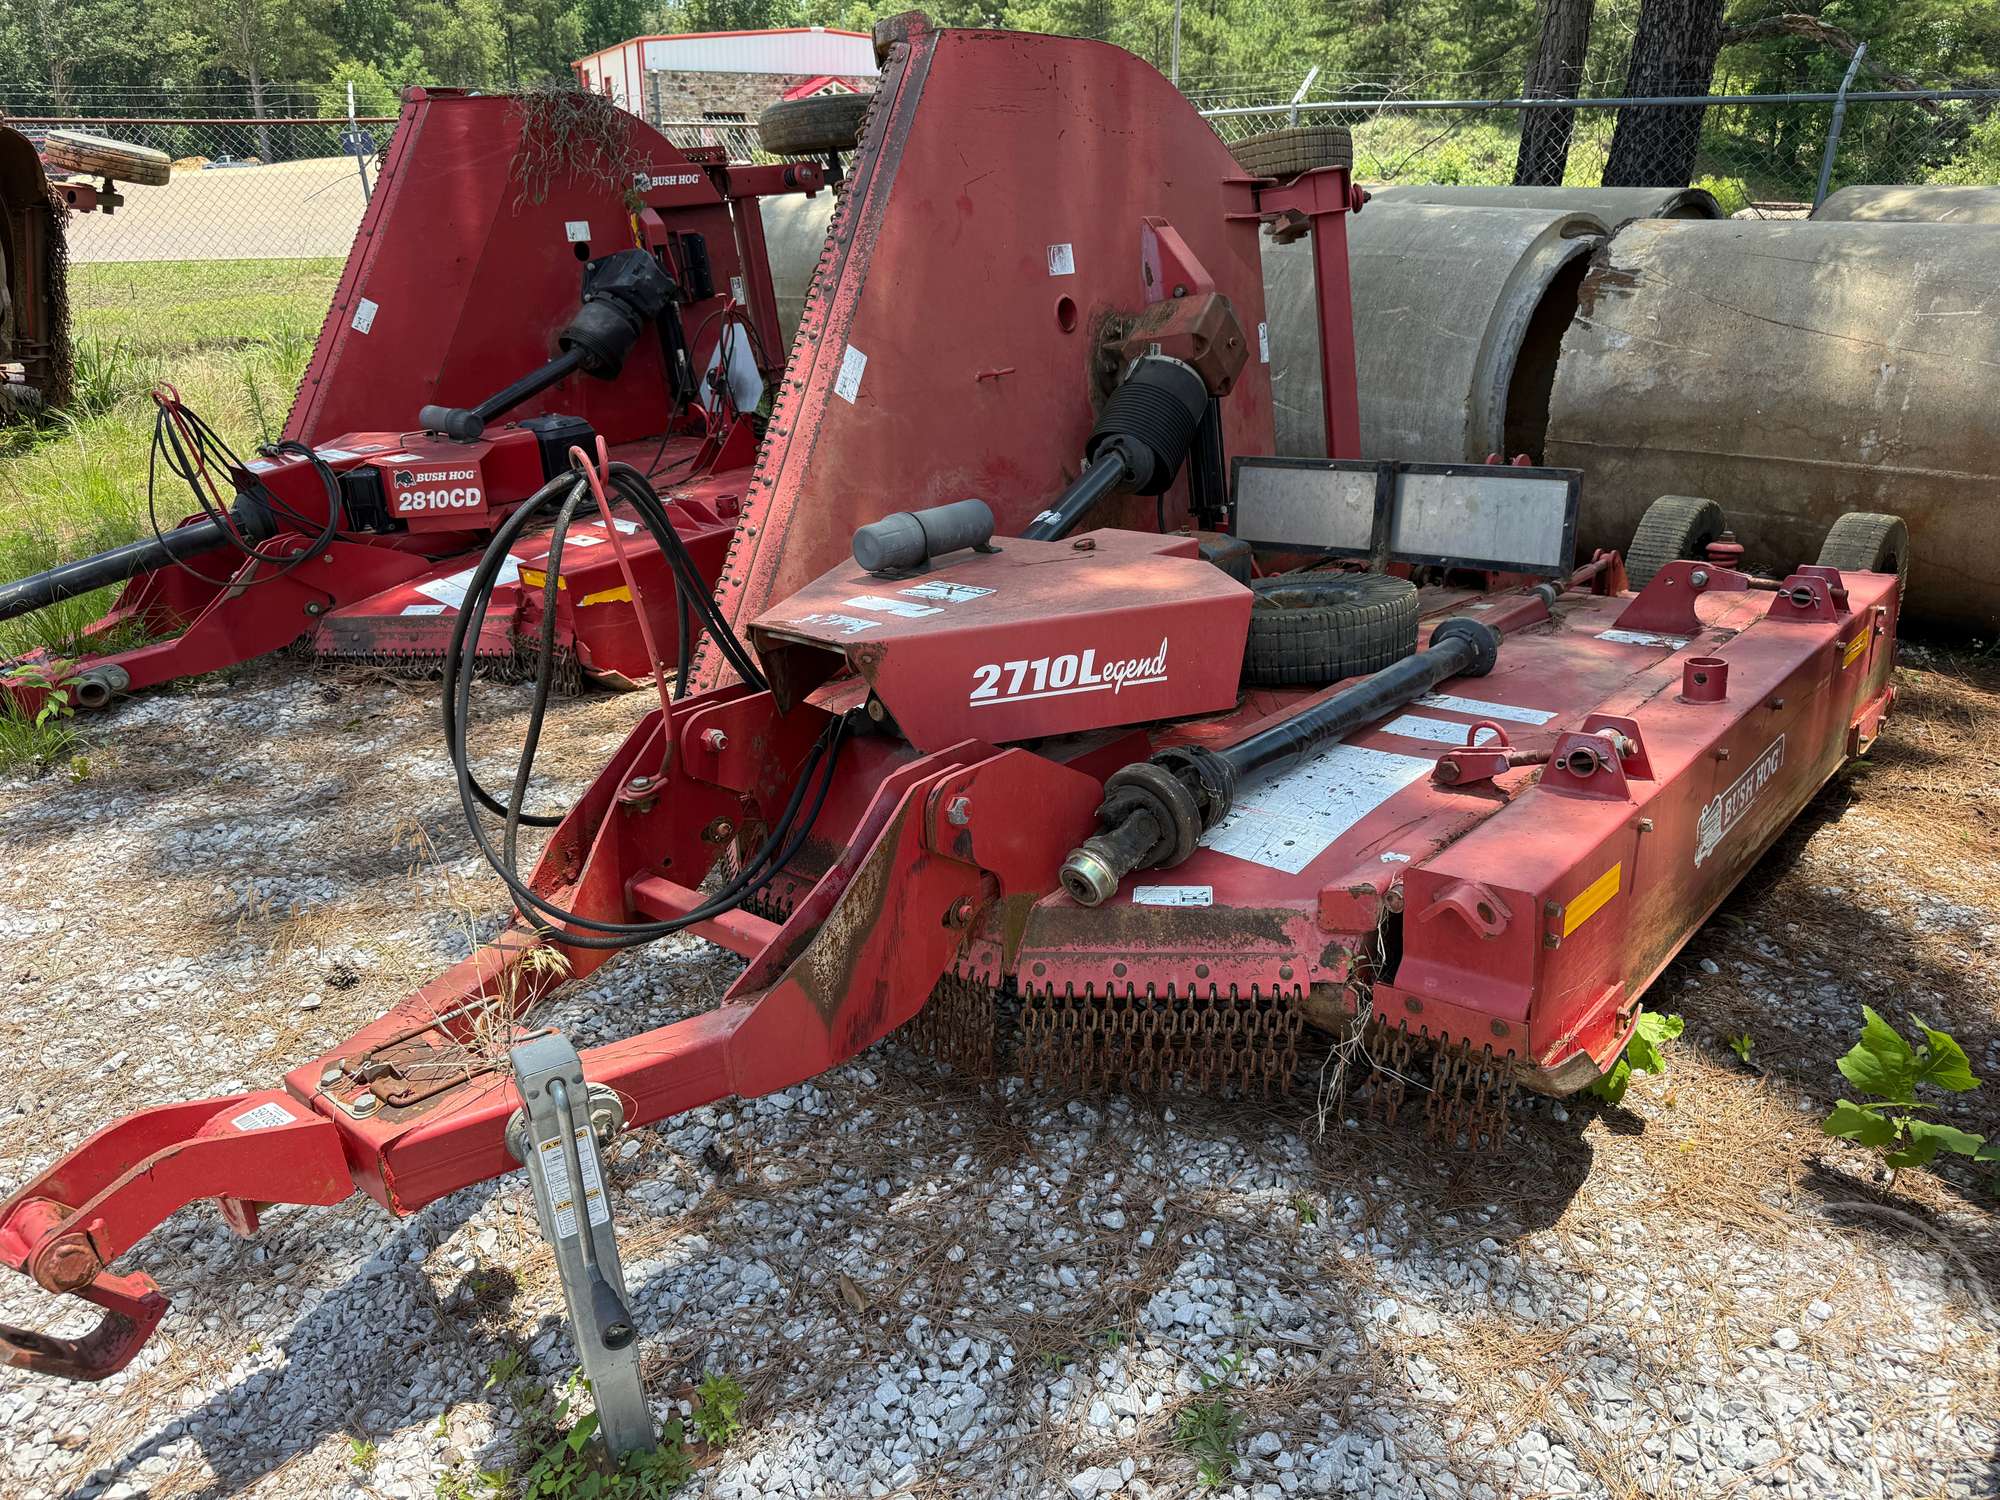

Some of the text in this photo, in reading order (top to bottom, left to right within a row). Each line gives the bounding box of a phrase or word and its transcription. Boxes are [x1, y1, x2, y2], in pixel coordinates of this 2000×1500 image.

[652, 174, 699, 187] BUSH HOG
[416, 470, 475, 482] BUSH HOG
[399, 487, 481, 511] 2810CD
[1723, 747, 1781, 826] BUSH HOG
